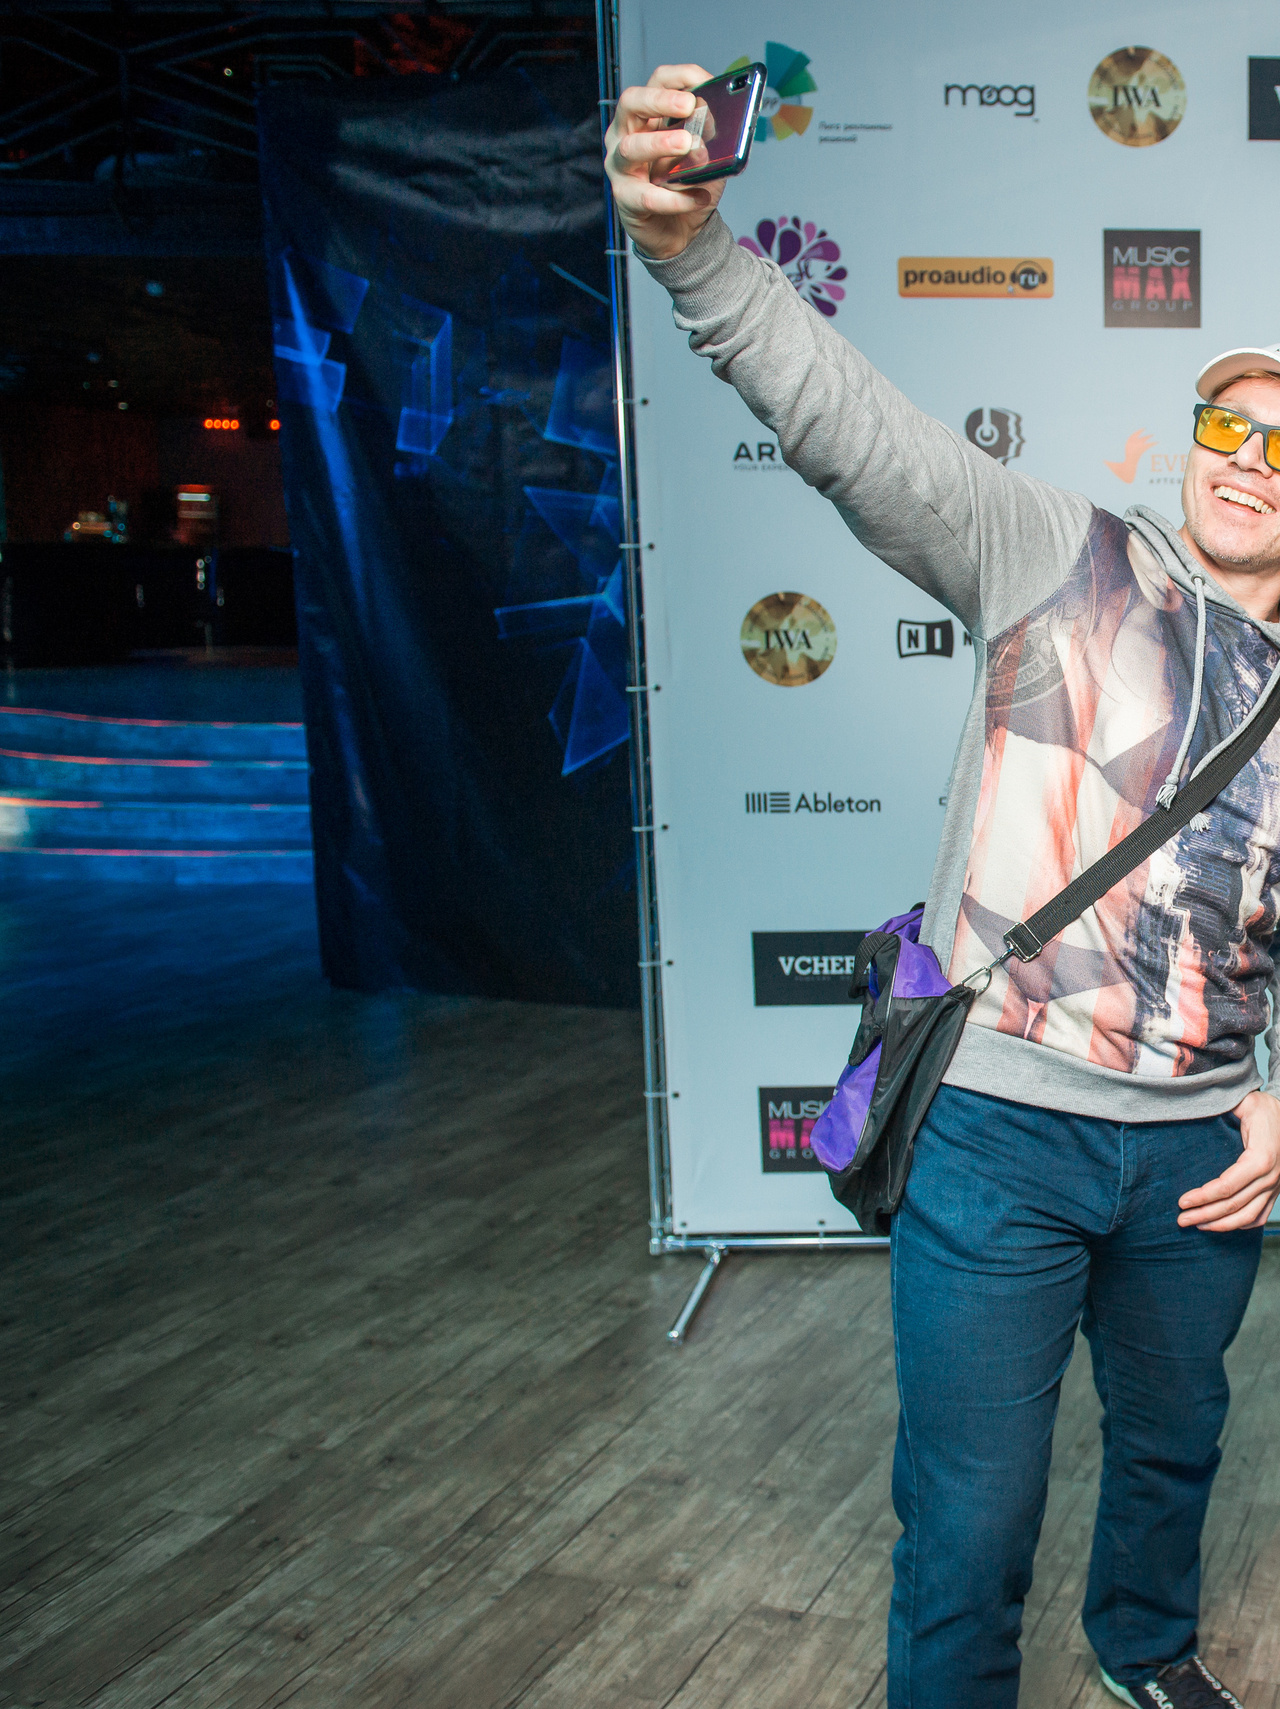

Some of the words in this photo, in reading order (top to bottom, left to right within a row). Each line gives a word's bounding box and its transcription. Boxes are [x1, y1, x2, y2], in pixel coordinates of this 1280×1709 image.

[944, 84, 1036, 117] moog
[1112, 245, 1191, 267] MUSIC
[904, 265, 1006, 288] proaudio
[1112, 266, 1192, 300] MAX
[1112, 301, 1194, 312] GROUP
[794, 792, 881, 813] Ableton
[768, 1149, 815, 1161] GRO
